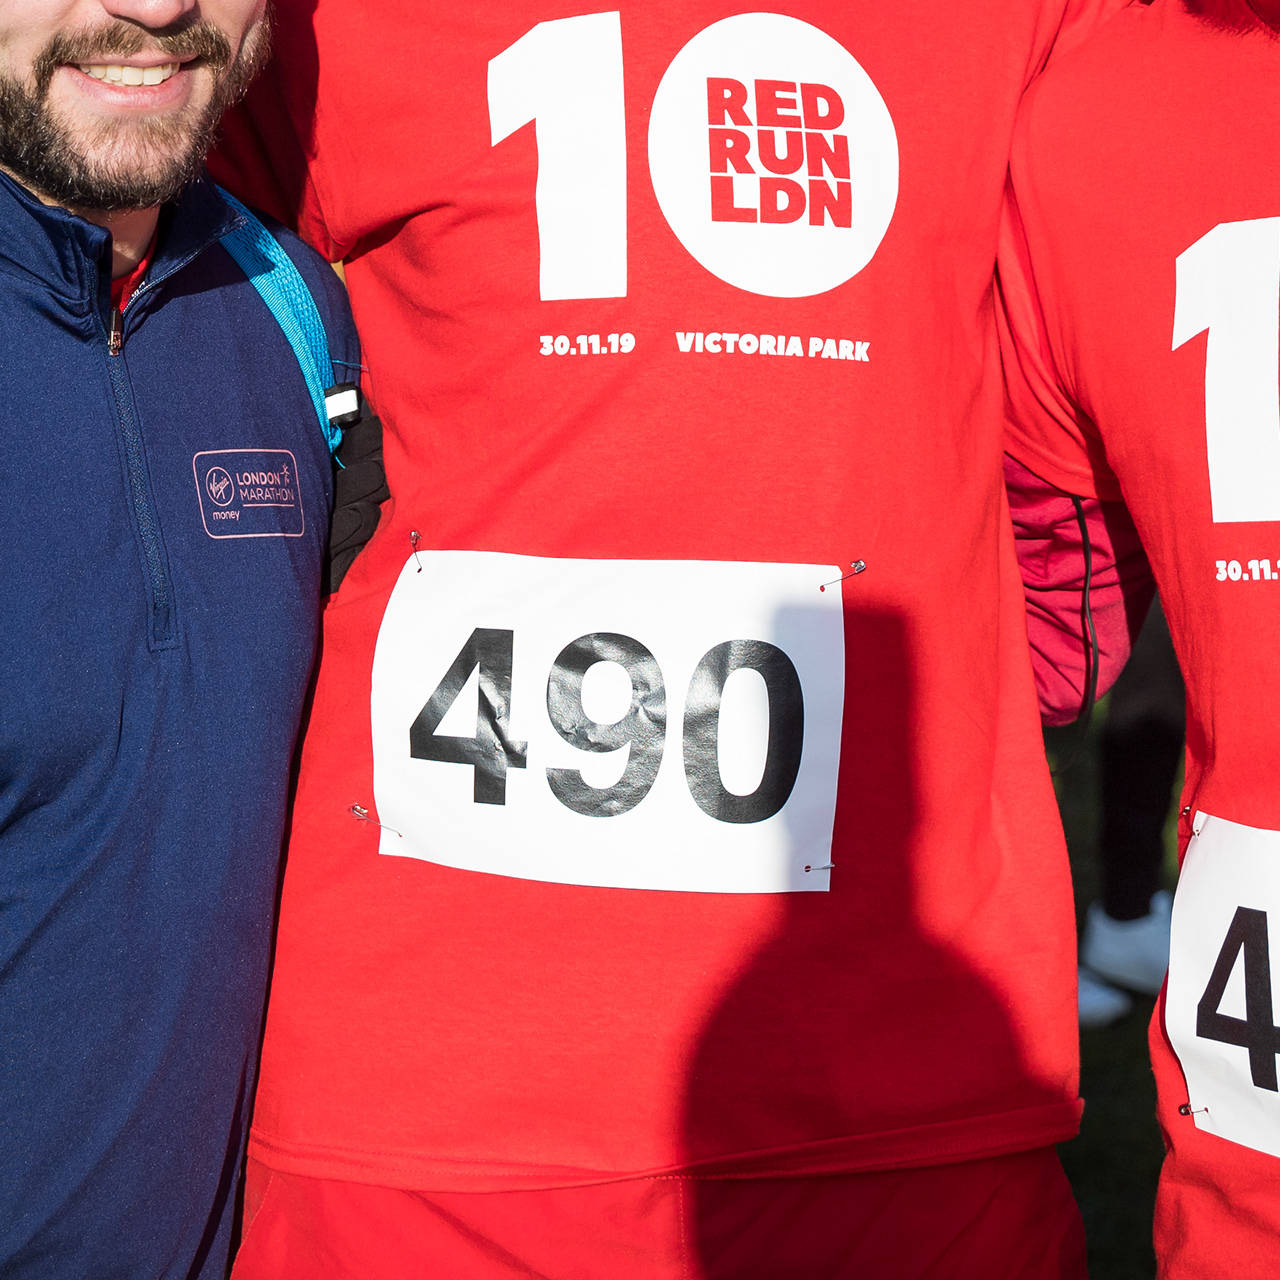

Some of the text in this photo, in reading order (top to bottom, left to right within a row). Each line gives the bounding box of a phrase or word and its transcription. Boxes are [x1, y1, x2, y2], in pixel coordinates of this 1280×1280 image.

[706, 76, 845, 131] RED
[487, 10, 899, 301] 10
[708, 128, 851, 180] RUN
[710, 176, 852, 228] LDN
[538, 331, 871, 362] 30.11.19 VICTORIA PARK
[235, 471, 281, 486] LONDON
[239, 487, 295, 501] MARATHON
[212, 510, 240, 521] money
[409, 626, 806, 825] 490
